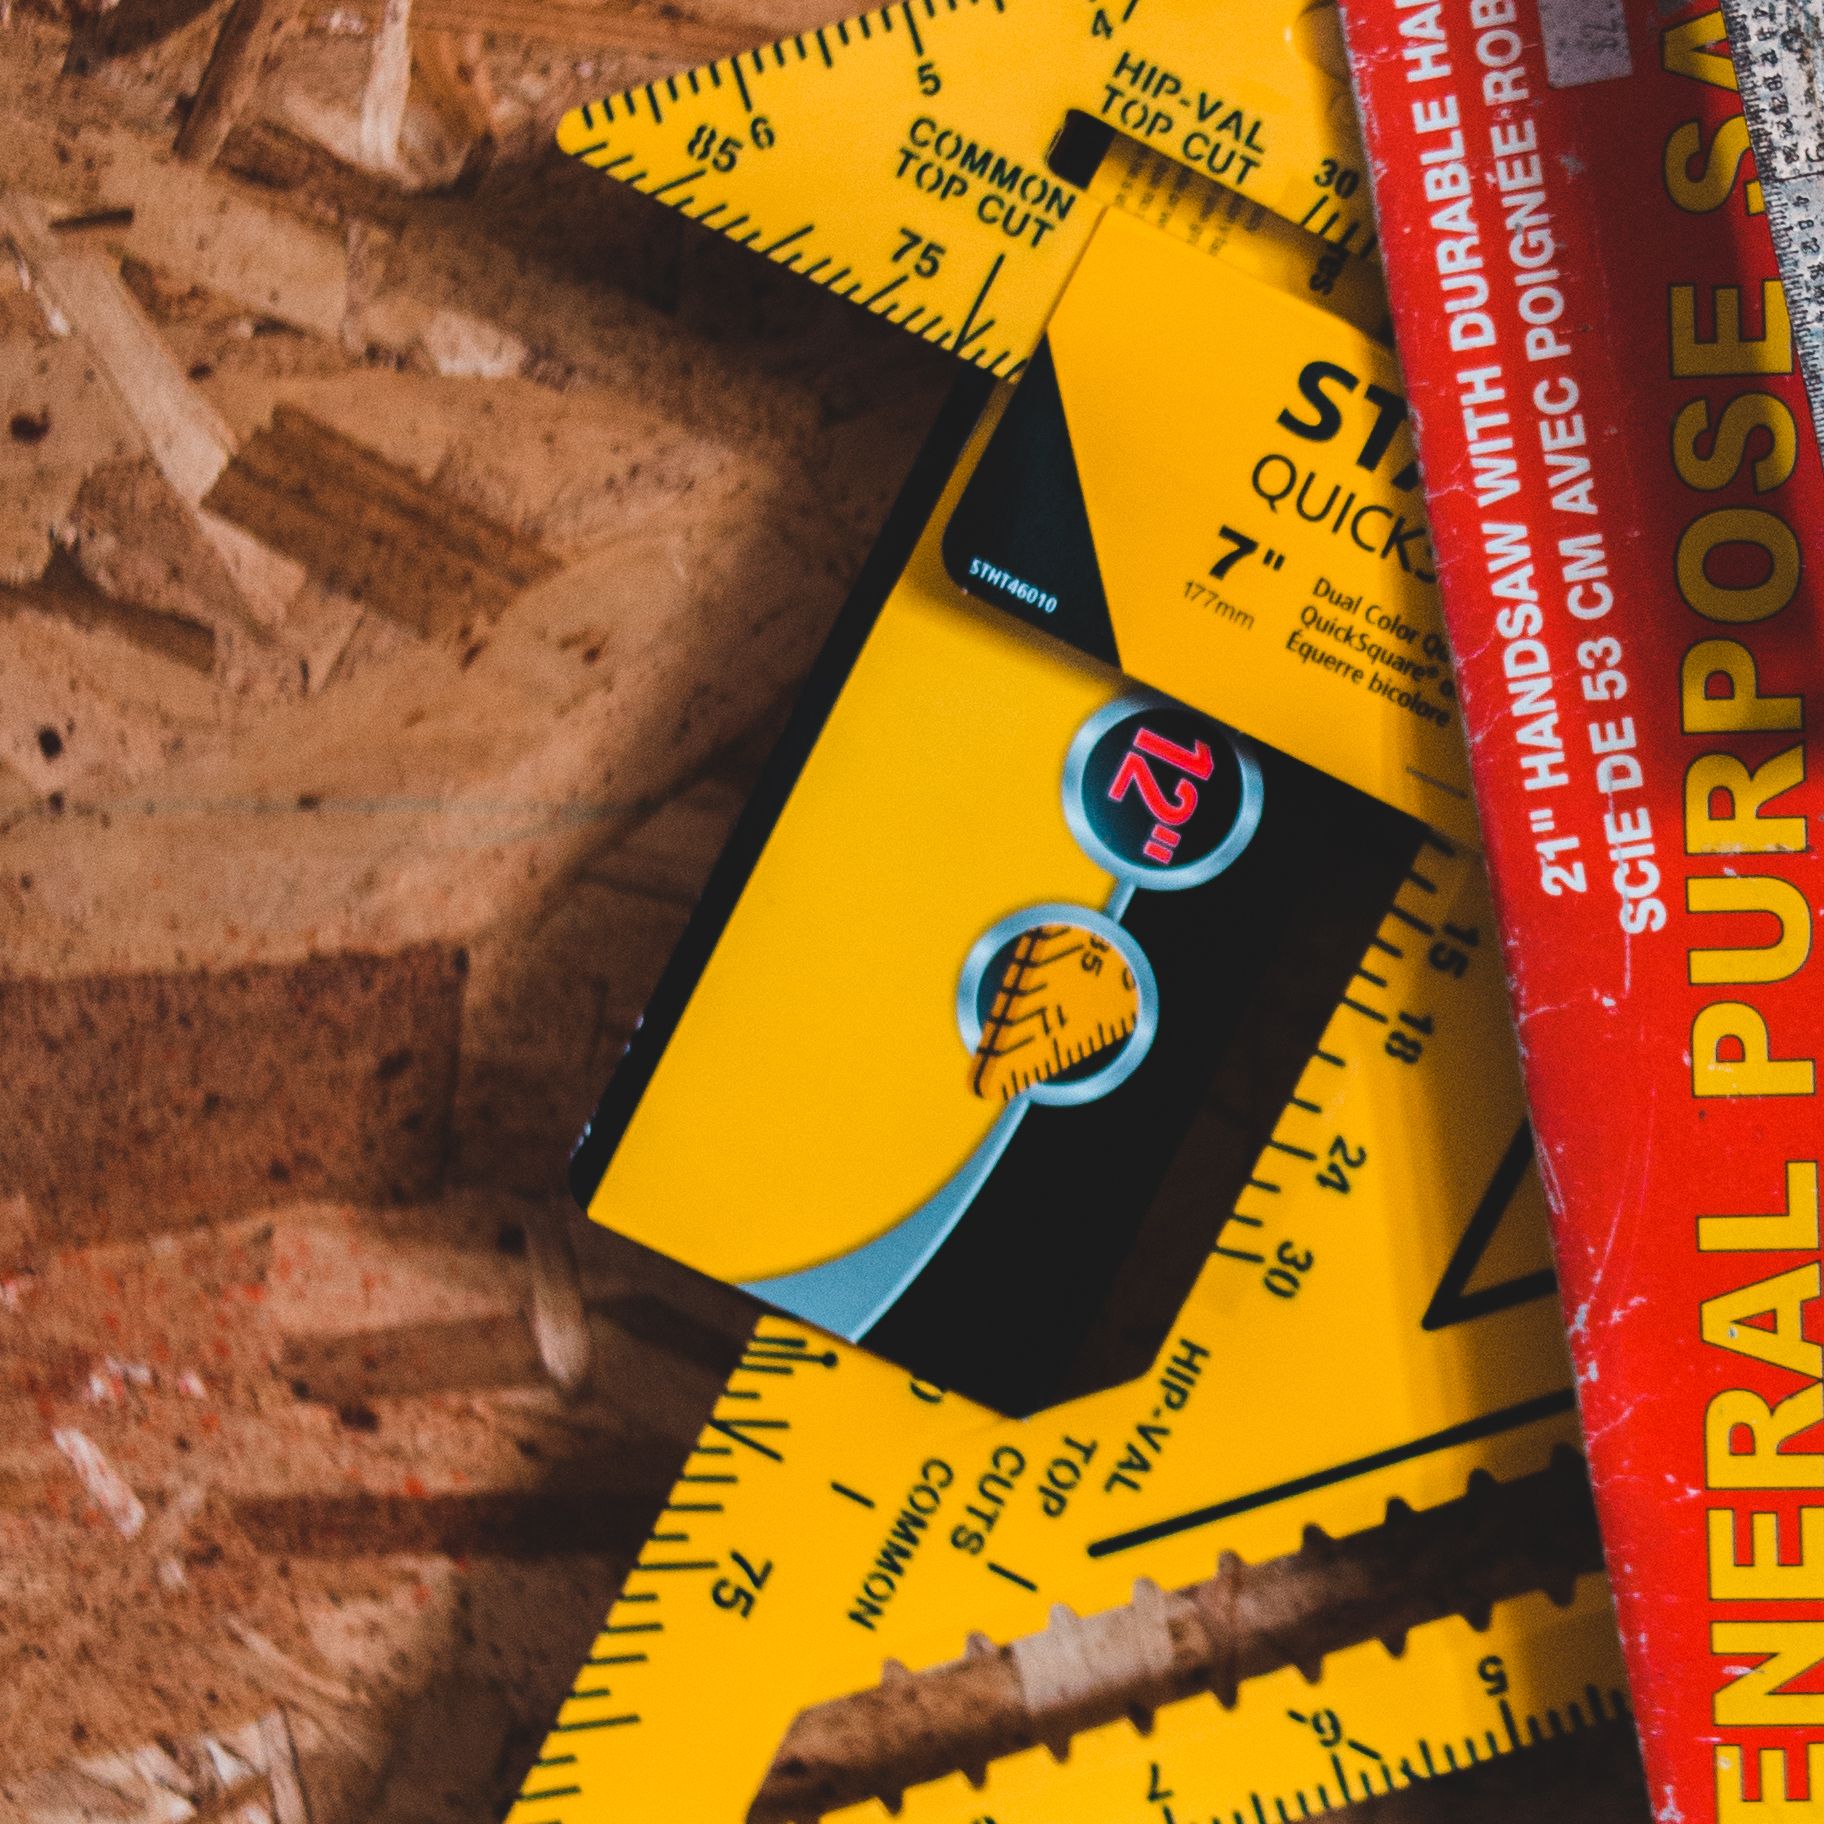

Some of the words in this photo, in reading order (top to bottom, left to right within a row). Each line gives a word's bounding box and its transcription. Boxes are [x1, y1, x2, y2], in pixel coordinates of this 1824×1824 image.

[1091, 8, 1114, 40] 4
[917, 62, 941, 96] 5
[1112, 51, 1267, 154] HIP-VAL
[686, 124, 744, 173] 85
[750, 116, 775, 150] 6
[909, 117, 1076, 221] COMMON
[1100, 84, 1173, 138] TOP
[1182, 130, 1262, 186] CUT
[896, 147, 967, 201] TOP
[977, 193, 1054, 248] CUT
[1314, 159, 1358, 201] 30
[890, 227, 947, 278] 75
[1412, 96, 1497, 351] DURABLE
[1489, 120, 1572, 361] POIGNÉE
[1455, 366, 1520, 506] WITH
[1533, 376, 1599, 516] AVEC
[968, 557, 1058, 614] STHT46010
[1208, 525, 1286, 580] 7"
[1558, 533, 1614, 621] CM
[1183, 580, 1255, 629] 177mm
[1313, 577, 1360, 616] Dual
[1365, 602, 1421, 646] Color
[1286, 629, 1364, 685] Équerre
[1368, 665, 1451, 727] bicolore
[1481, 521, 1569, 791] HANDSAW
[1577, 636, 1627, 702] 53
[1669, 279, 1816, 1099] PURPOSE
[1588, 717, 1645, 793] DE
[1109, 727, 1214, 865] 12"
[1529, 810, 1586, 896] 21"
[1603, 808, 1667, 935] SCIE
[1427, 922, 1479, 978] 15
[1384, 1011, 1434, 1064] 18
[1316, 1134, 1366, 1194] 24
[1263, 1241, 1314, 1299] 30
[1104, 1338, 1210, 1495] HIP-VAL
[949, 1445, 1025, 1556] CUTS
[1037, 1435, 1098, 1518] TOP
[848, 1458, 954, 1631] COMMON
[711, 1550, 774, 1619] 75
[1478, 1654, 1508, 1696] 5
[1145, 1763, 1173, 1803] 7
